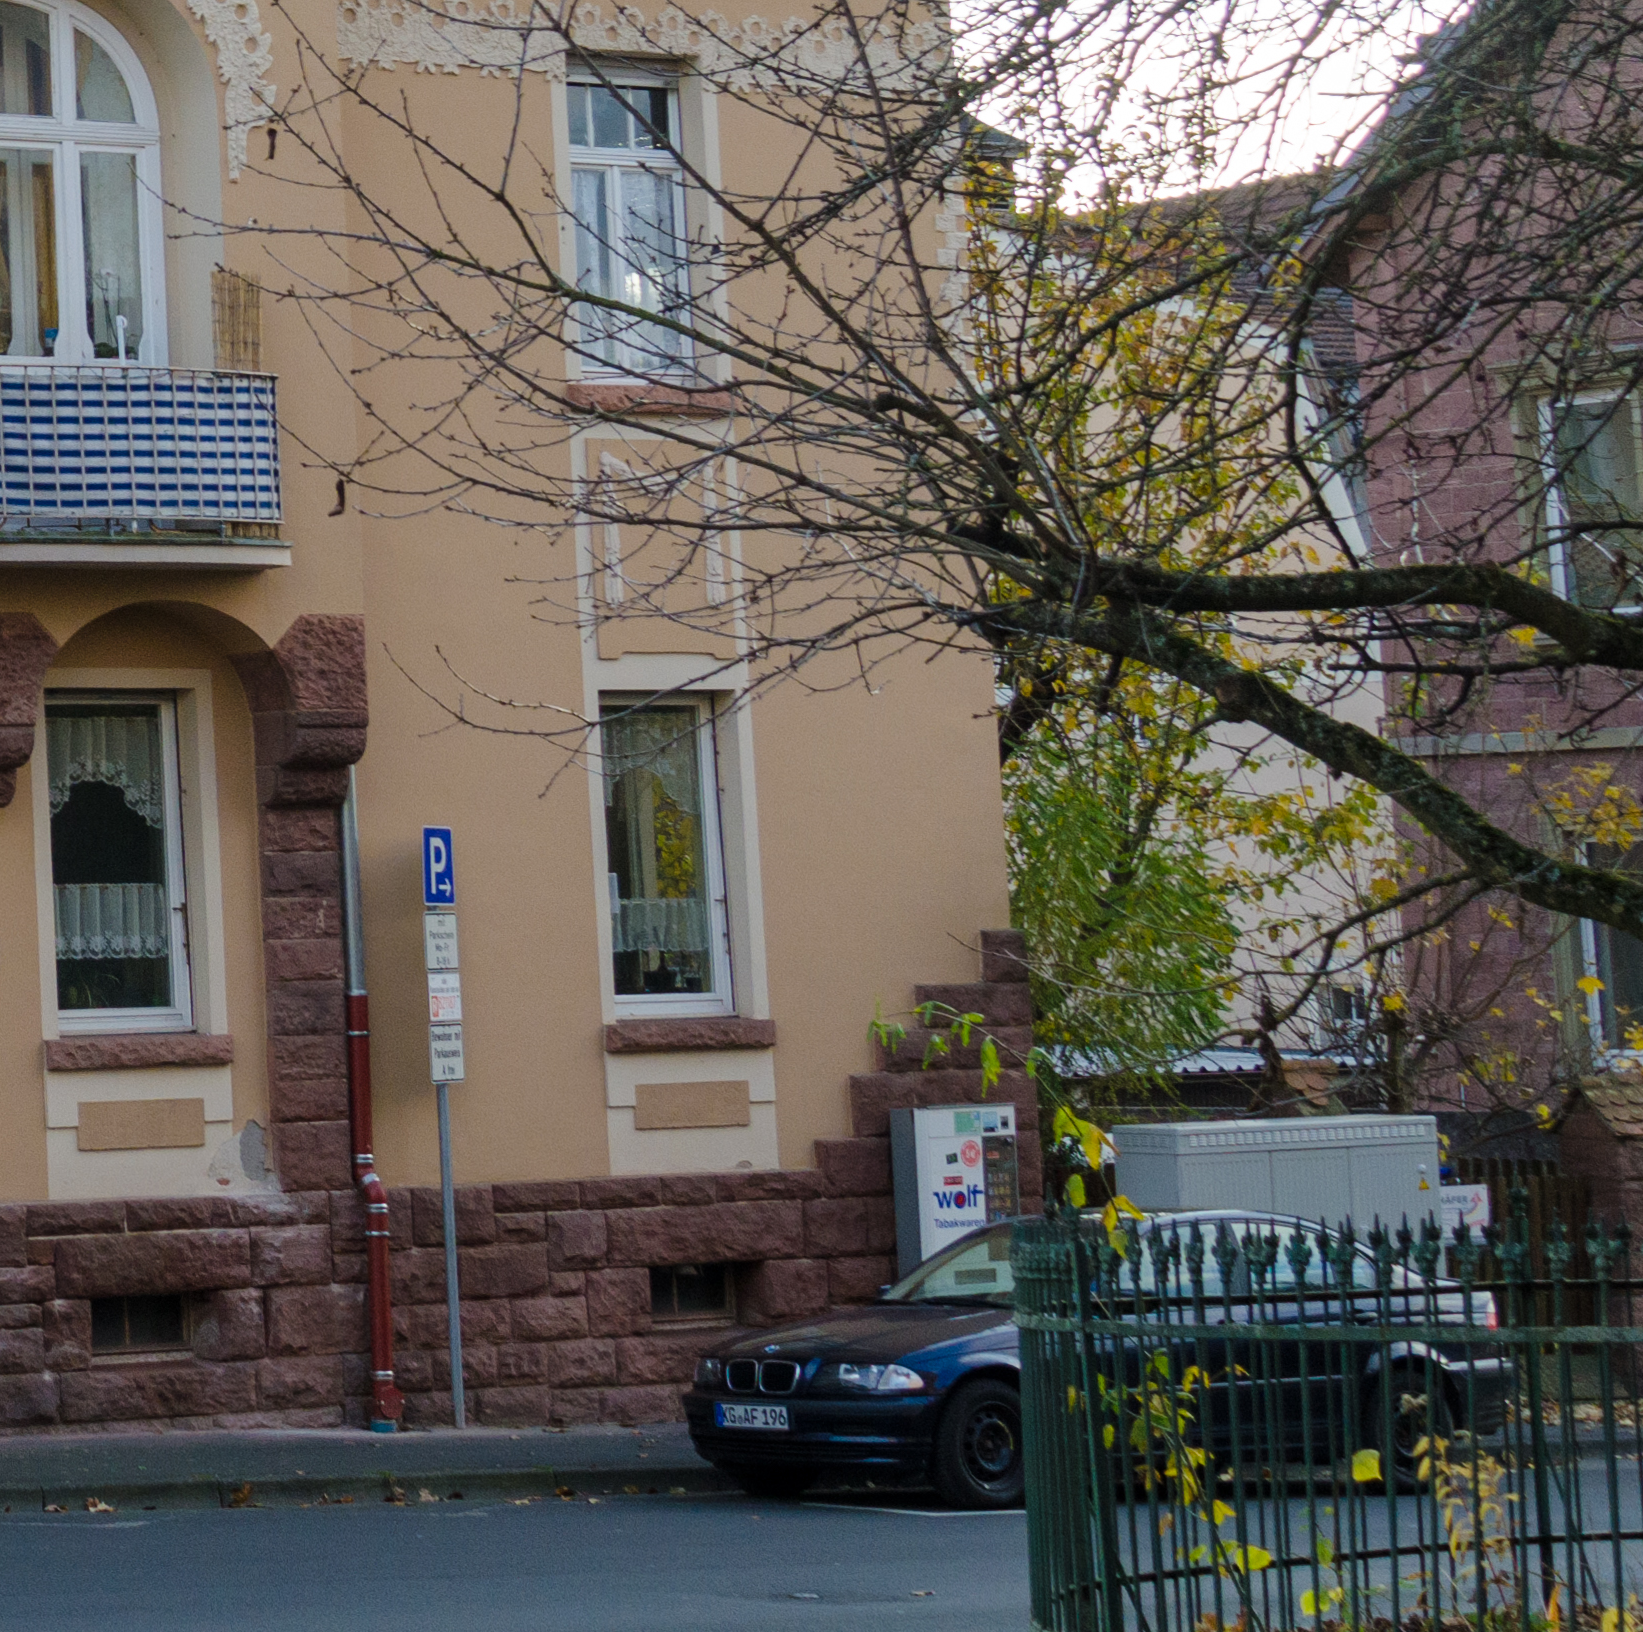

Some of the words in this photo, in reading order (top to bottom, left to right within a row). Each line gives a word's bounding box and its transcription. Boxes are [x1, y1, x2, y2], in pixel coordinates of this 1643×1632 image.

[429, 837, 446, 895] P
[934, 1219, 986, 1229] Tabakwaren
[723, 1406, 736, 1424] KG
[743, 1408, 758, 1425] AF
[762, 1409, 786, 1426] 196
